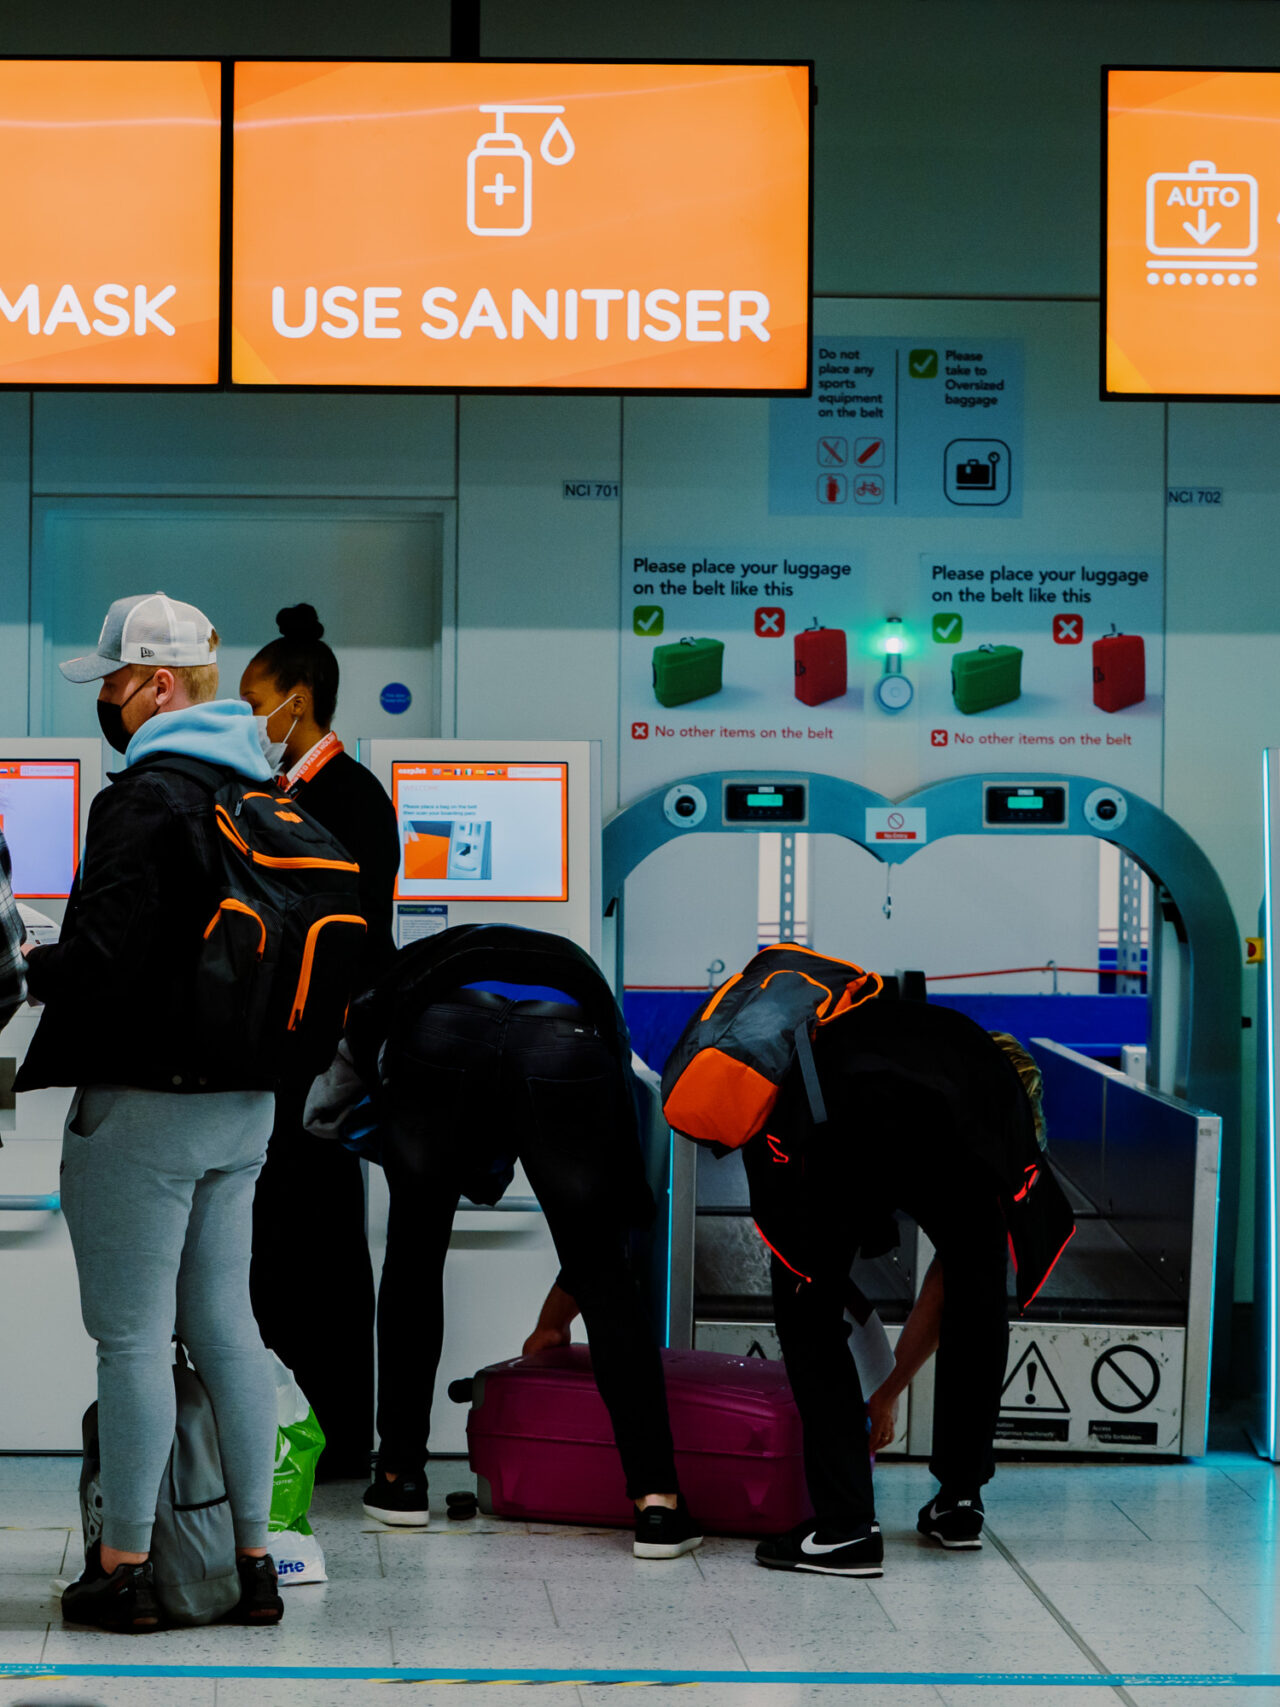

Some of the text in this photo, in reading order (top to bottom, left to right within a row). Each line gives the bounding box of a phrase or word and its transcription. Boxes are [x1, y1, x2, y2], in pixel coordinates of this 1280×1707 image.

[1166, 186, 1240, 208] AUTO
[271, 285, 772, 342] USE SANITISER
[819, 349, 860, 360] Do not
[945, 350, 983, 362] Please
[819, 363, 874, 377] place any
[945, 365, 987, 376] take to
[818, 379, 856, 391] sports
[945, 379, 1005, 391] Oversized
[818, 393, 883, 406] equipment
[945, 393, 999, 408] baggage
[818, 407, 884, 418] on the belt
[565, 484, 618, 496] NCI 701
[1168, 491, 1222, 504] NCI 702
[634, 558, 851, 579] Please place your luggage
[932, 565, 1149, 586] Please place your luggage
[633, 580, 793, 596] on the belt like this
[932, 587, 1091, 603] on the belt like this
[655, 725, 834, 739] No other items on the belt
[954, 732, 1132, 746] No other items on the belt
